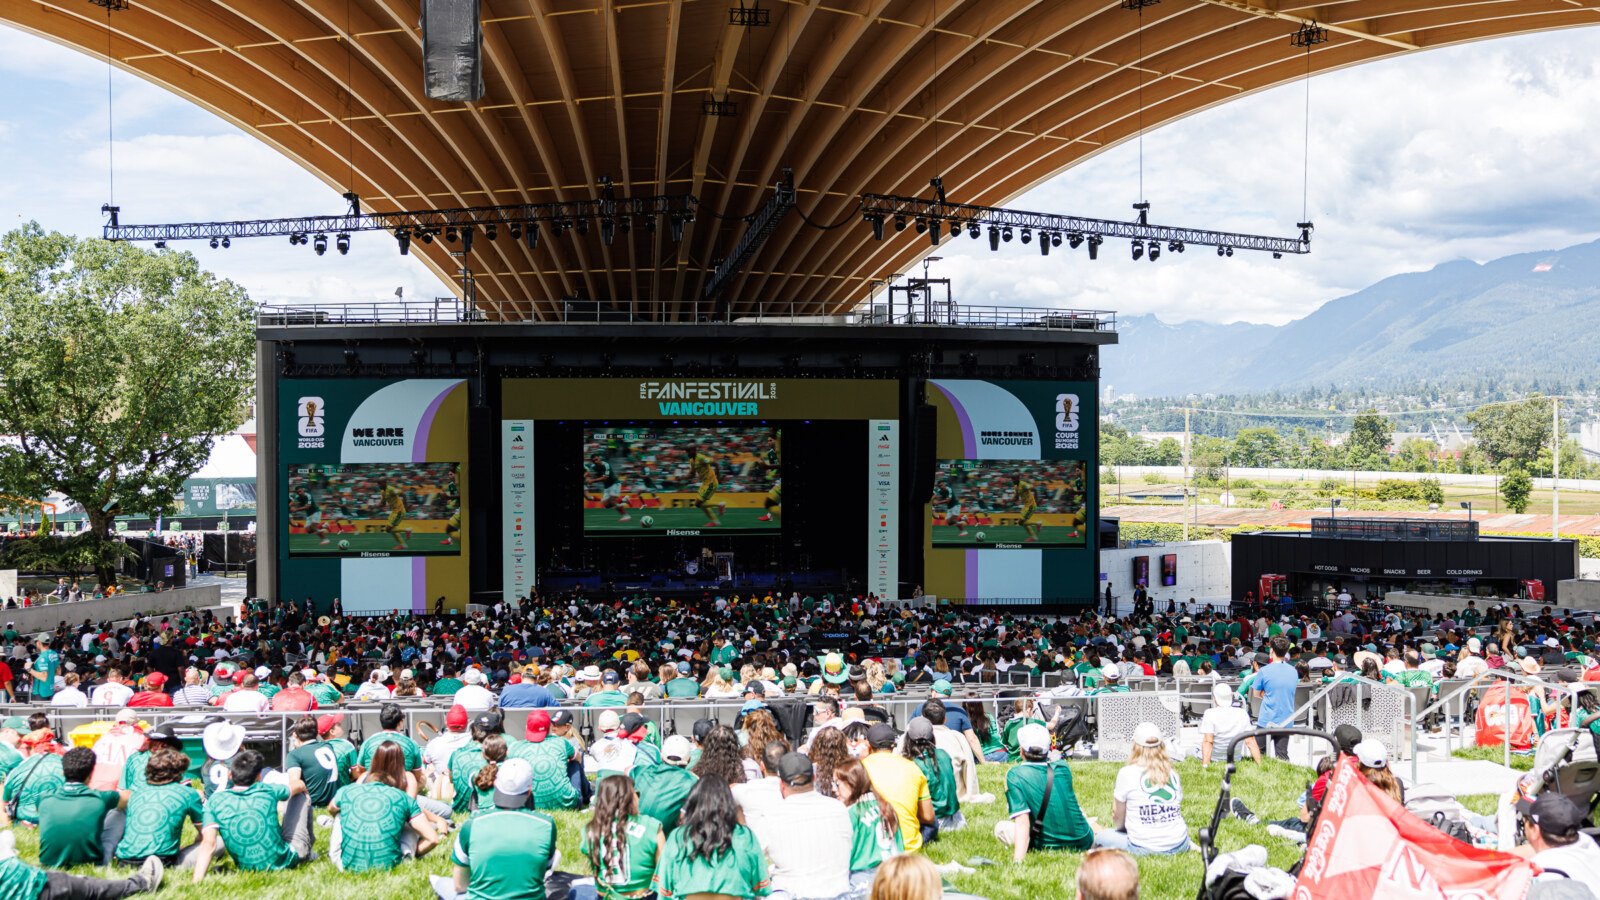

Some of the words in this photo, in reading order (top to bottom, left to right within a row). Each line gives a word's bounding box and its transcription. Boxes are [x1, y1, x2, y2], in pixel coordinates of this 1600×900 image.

[658, 401, 758, 416] VANCOUVER
[352, 427, 374, 438] WE
[352, 438, 404, 446] VANCOUVER
[981, 437, 1033, 446] VANCOUVER
[314, 746, 338, 784] 9
[209, 763, 229, 794] 9
